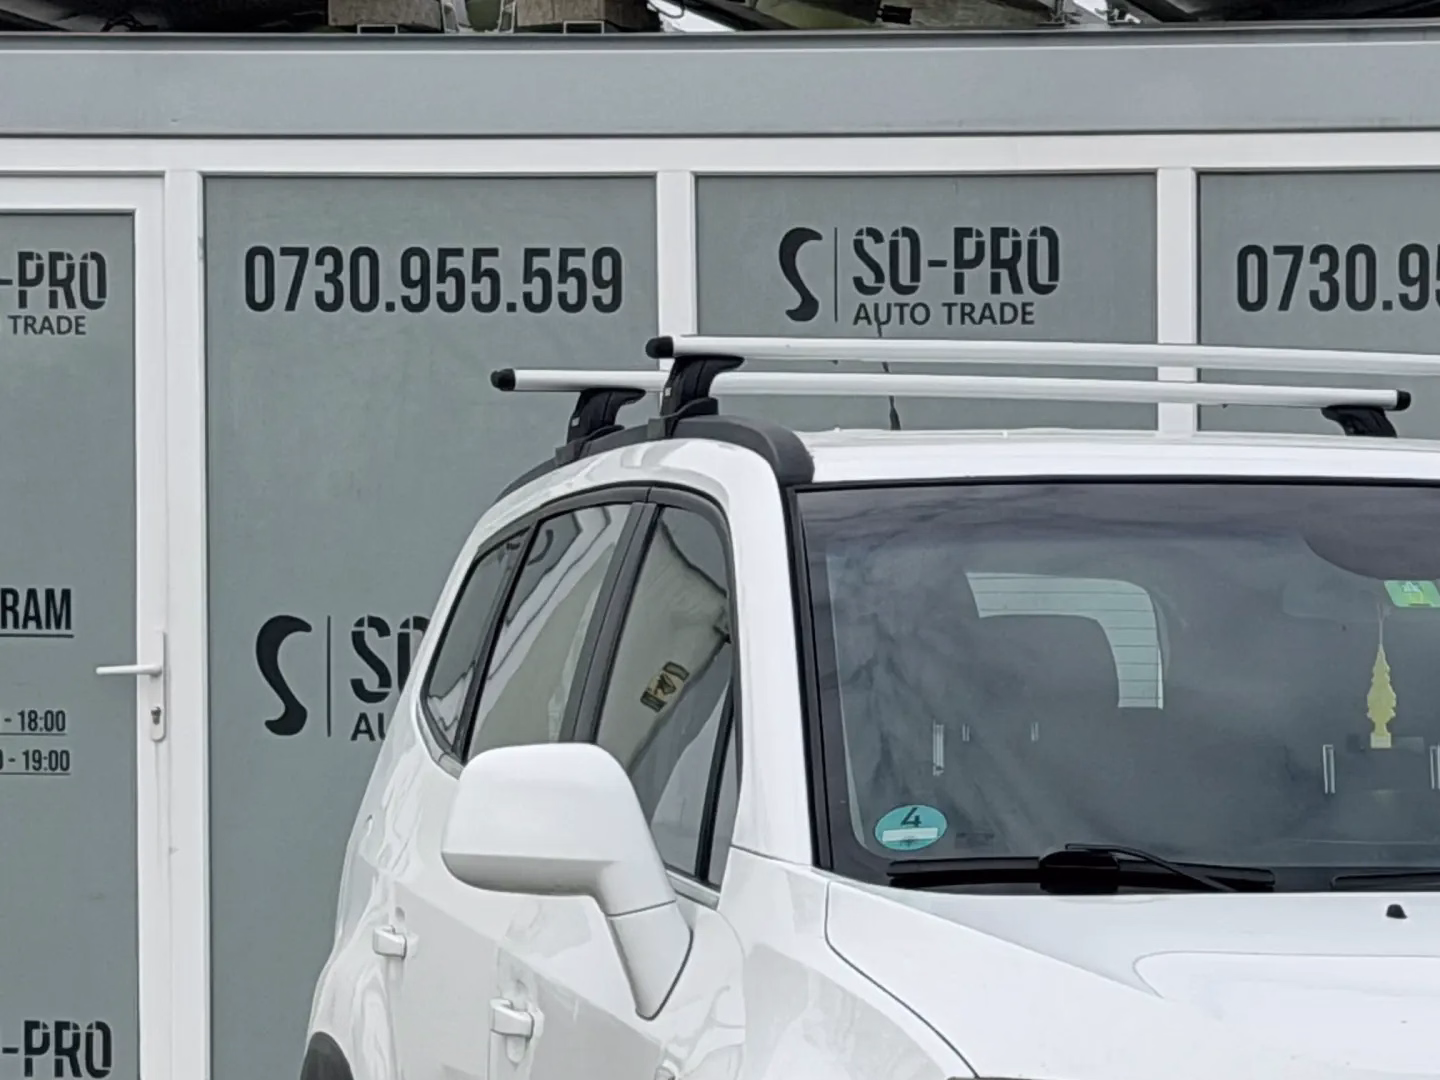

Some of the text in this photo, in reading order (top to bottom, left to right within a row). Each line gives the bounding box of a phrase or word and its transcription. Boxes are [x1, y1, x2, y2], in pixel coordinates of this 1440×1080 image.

[852, 225, 1060, 296] SO-PRO
[245, 246, 622, 313] 0730.955.559
[7, 315, 86, 335] TRADE
[852, 302, 1035, 326] AUTO TRADE
[0, 587, 72, 630] RAM
[17, 709, 66, 732] 18:00
[22, 749, 70, 771] 19:00
[900, 807, 922, 827] 4
